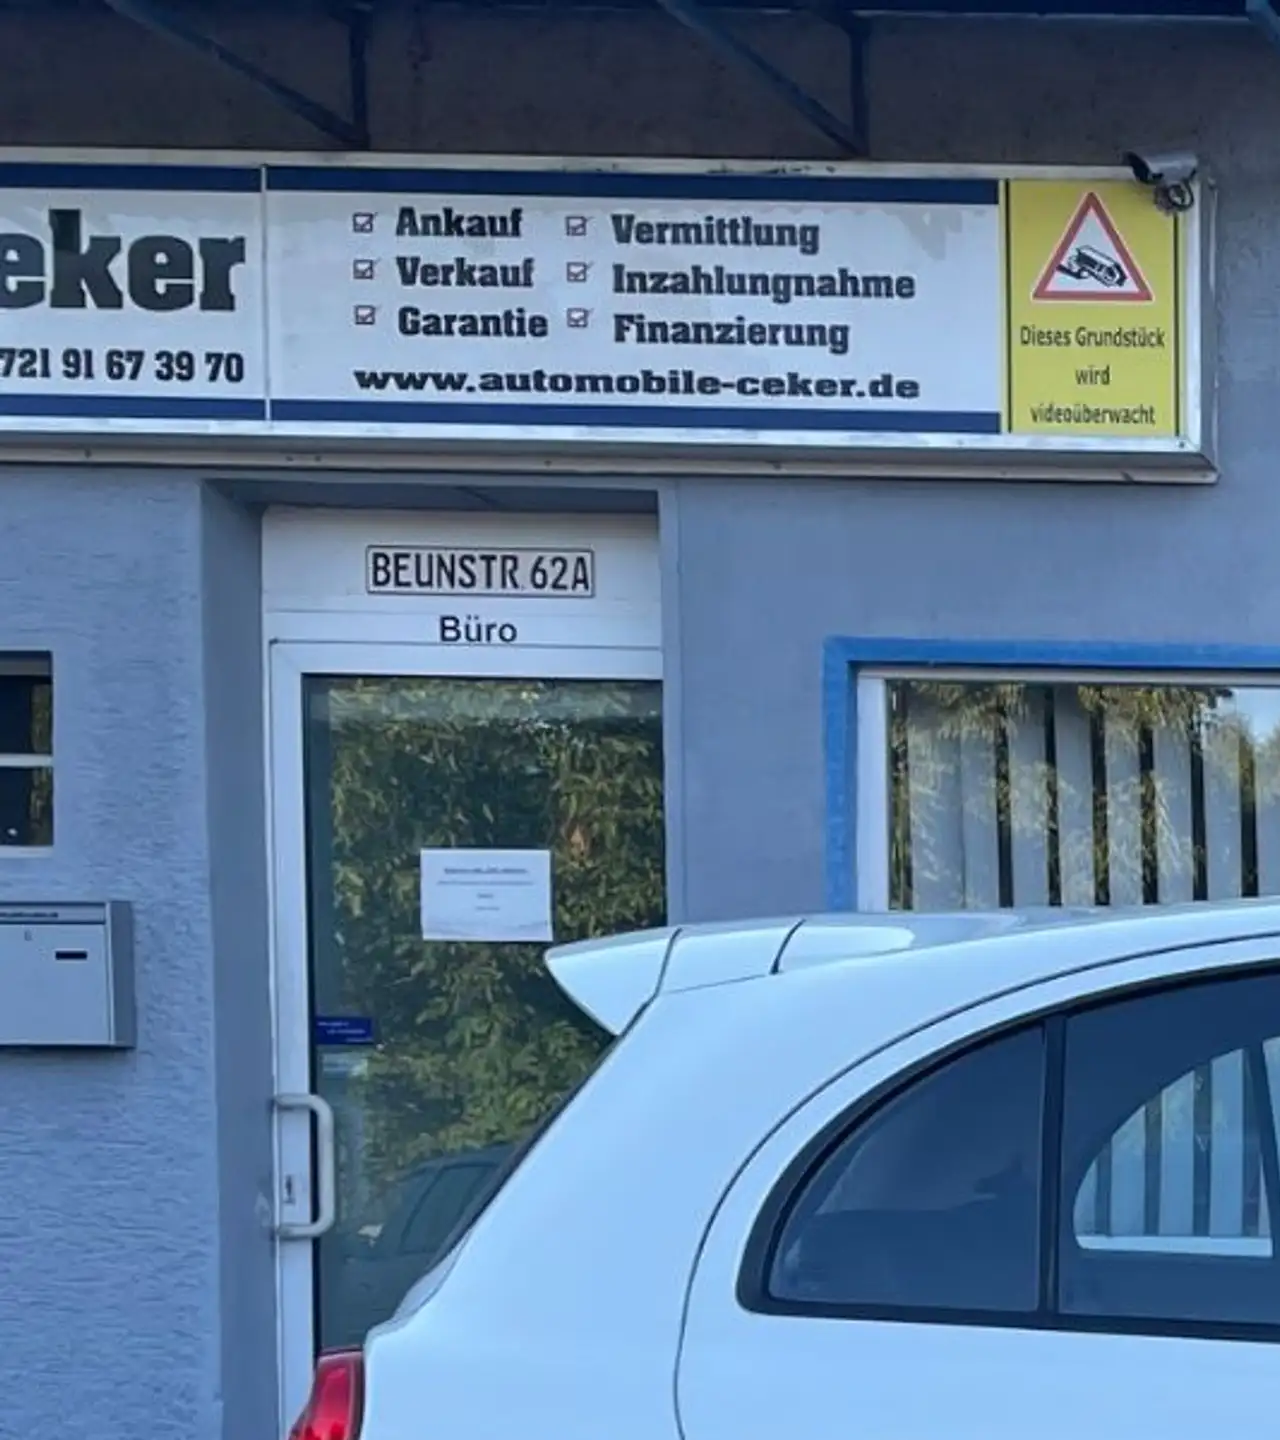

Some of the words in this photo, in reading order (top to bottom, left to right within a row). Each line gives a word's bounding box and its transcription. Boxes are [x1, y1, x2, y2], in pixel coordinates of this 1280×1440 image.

[395, 206, 523, 238] Ankauf
[610, 213, 820, 255] Vermittlung
[395, 255, 535, 288] Verkauf
[611, 263, 916, 304] Inzahlungnahme
[398, 306, 549, 338] Garantie
[613, 313, 850, 355] Finanzierung
[1019, 325, 1072, 347] Dieses
[1075, 325, 1166, 349] Grundstück
[62, 348, 95, 380] 91
[106, 349, 145, 381] 67
[154, 350, 195, 382] 39
[204, 352, 244, 383] 70
[1075, 364, 1111, 386] wird
[354, 369, 920, 399] www.automobile-ceker.de
[1030, 403, 1156, 425] videoüberwacht
[530, 555, 590, 591] 62A
[439, 614, 518, 643] Büro
